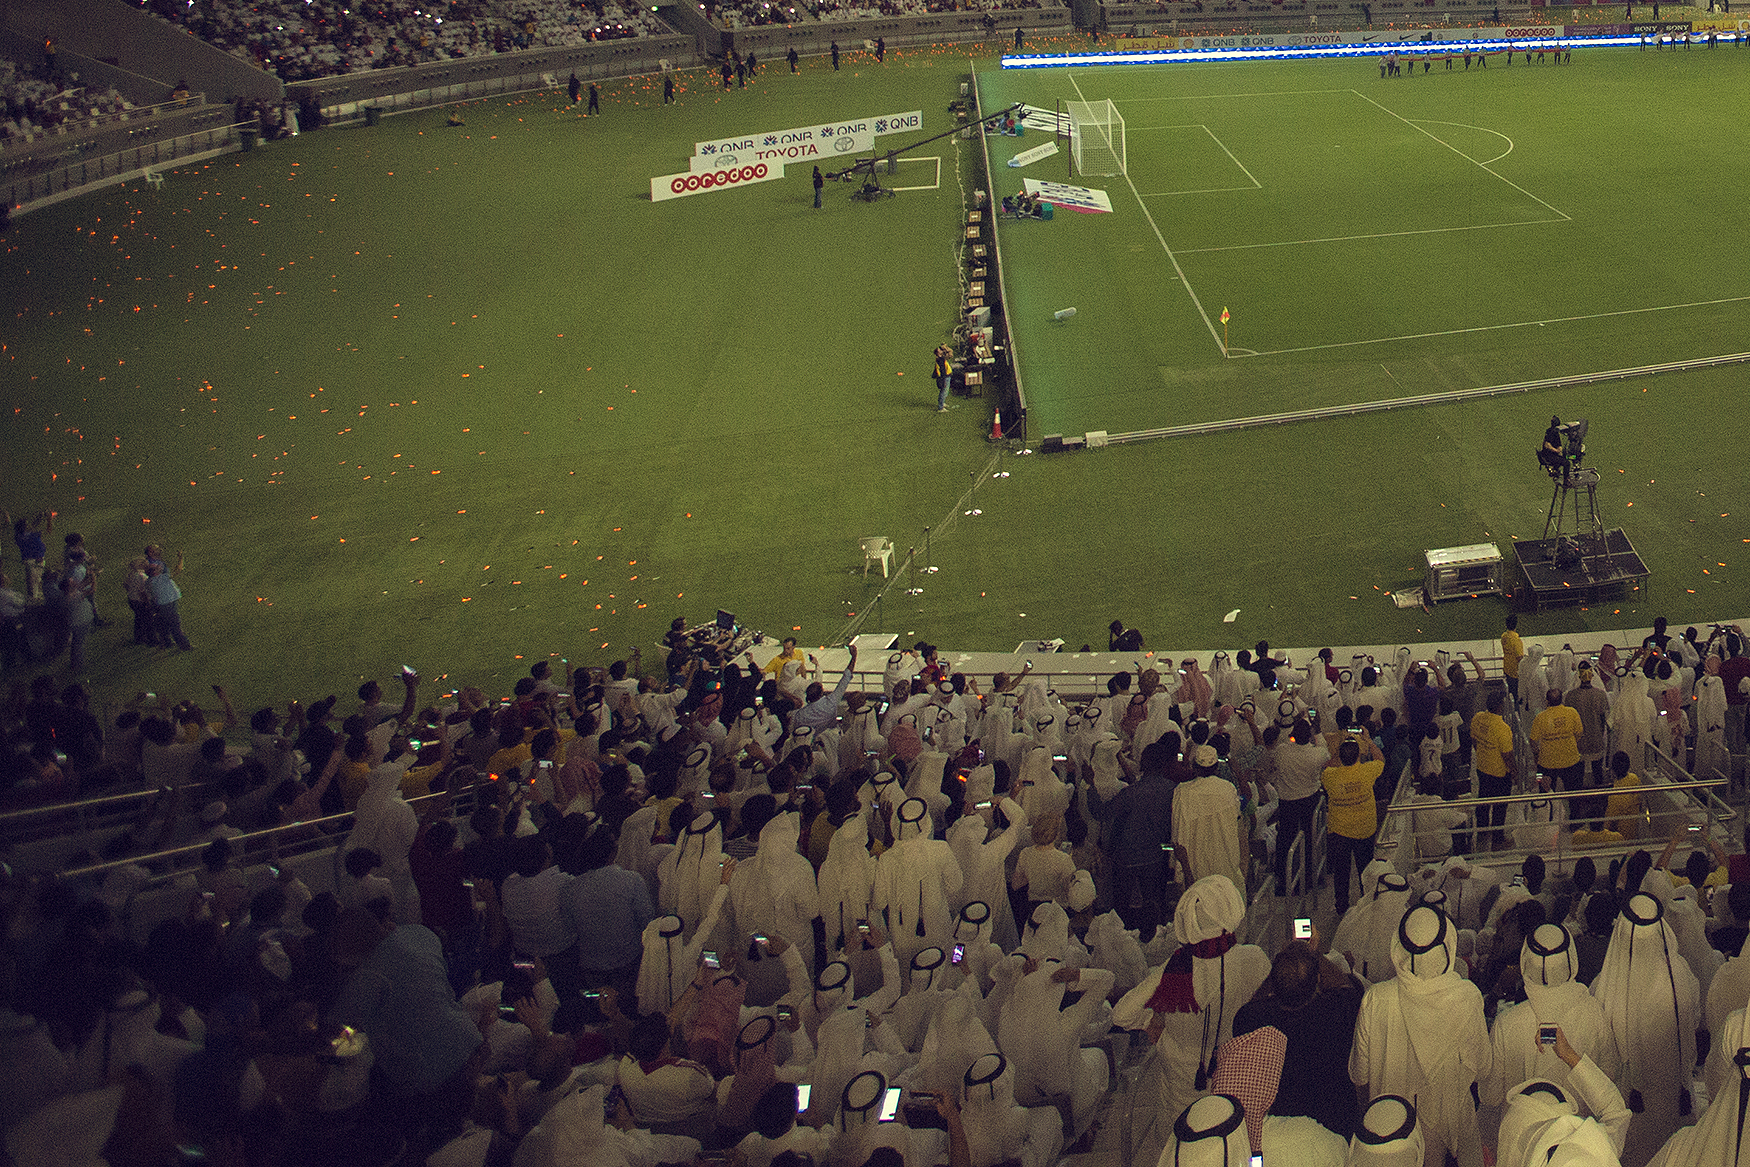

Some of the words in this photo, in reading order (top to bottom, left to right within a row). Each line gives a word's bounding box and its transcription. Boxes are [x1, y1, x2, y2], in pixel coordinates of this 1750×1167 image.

[1504, 28, 1556, 38] ooredoo
[1212, 38, 1236, 47] QNB
[1252, 37, 1274, 45] QNB
[1303, 35, 1342, 44] TOYOTA
[890, 116, 919, 130] QNB
[756, 144, 818, 160] TOYOTA
[670, 163, 768, 194] ooredoo
